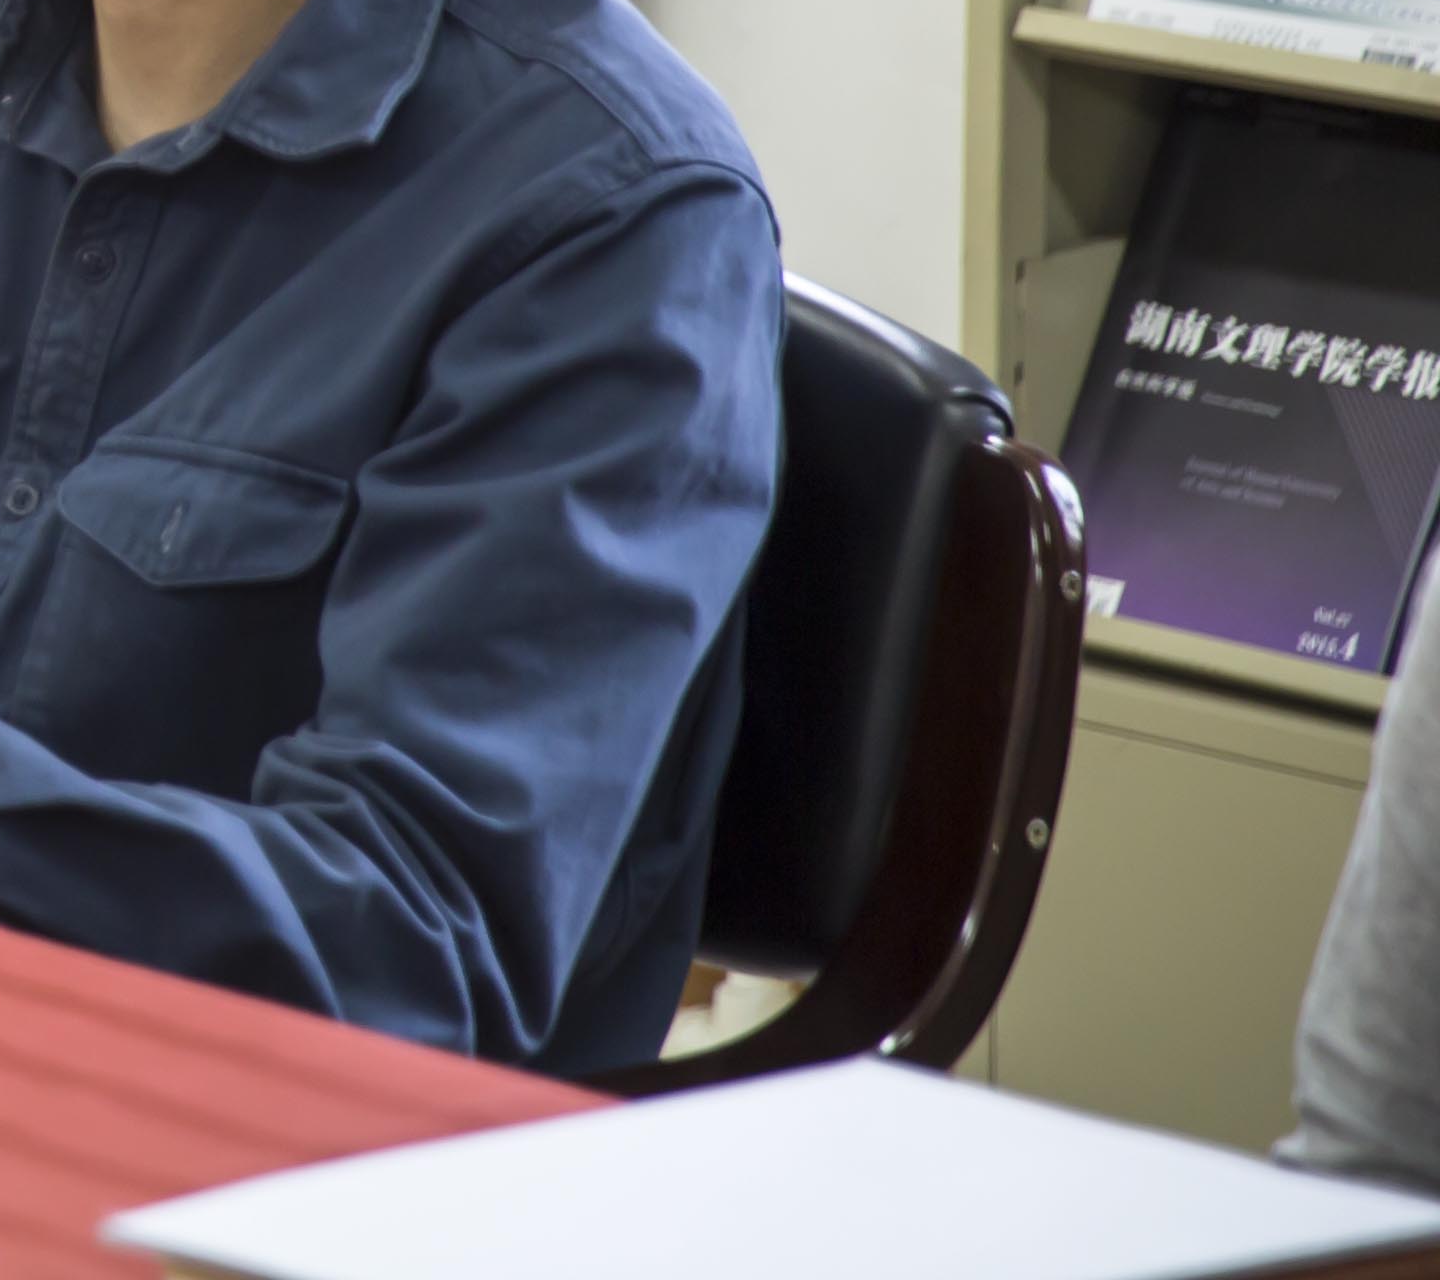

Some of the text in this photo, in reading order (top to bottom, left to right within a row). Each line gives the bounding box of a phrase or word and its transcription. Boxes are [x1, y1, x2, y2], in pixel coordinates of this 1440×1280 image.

[1125, 300, 1440, 400] 湖南文理学院学报
